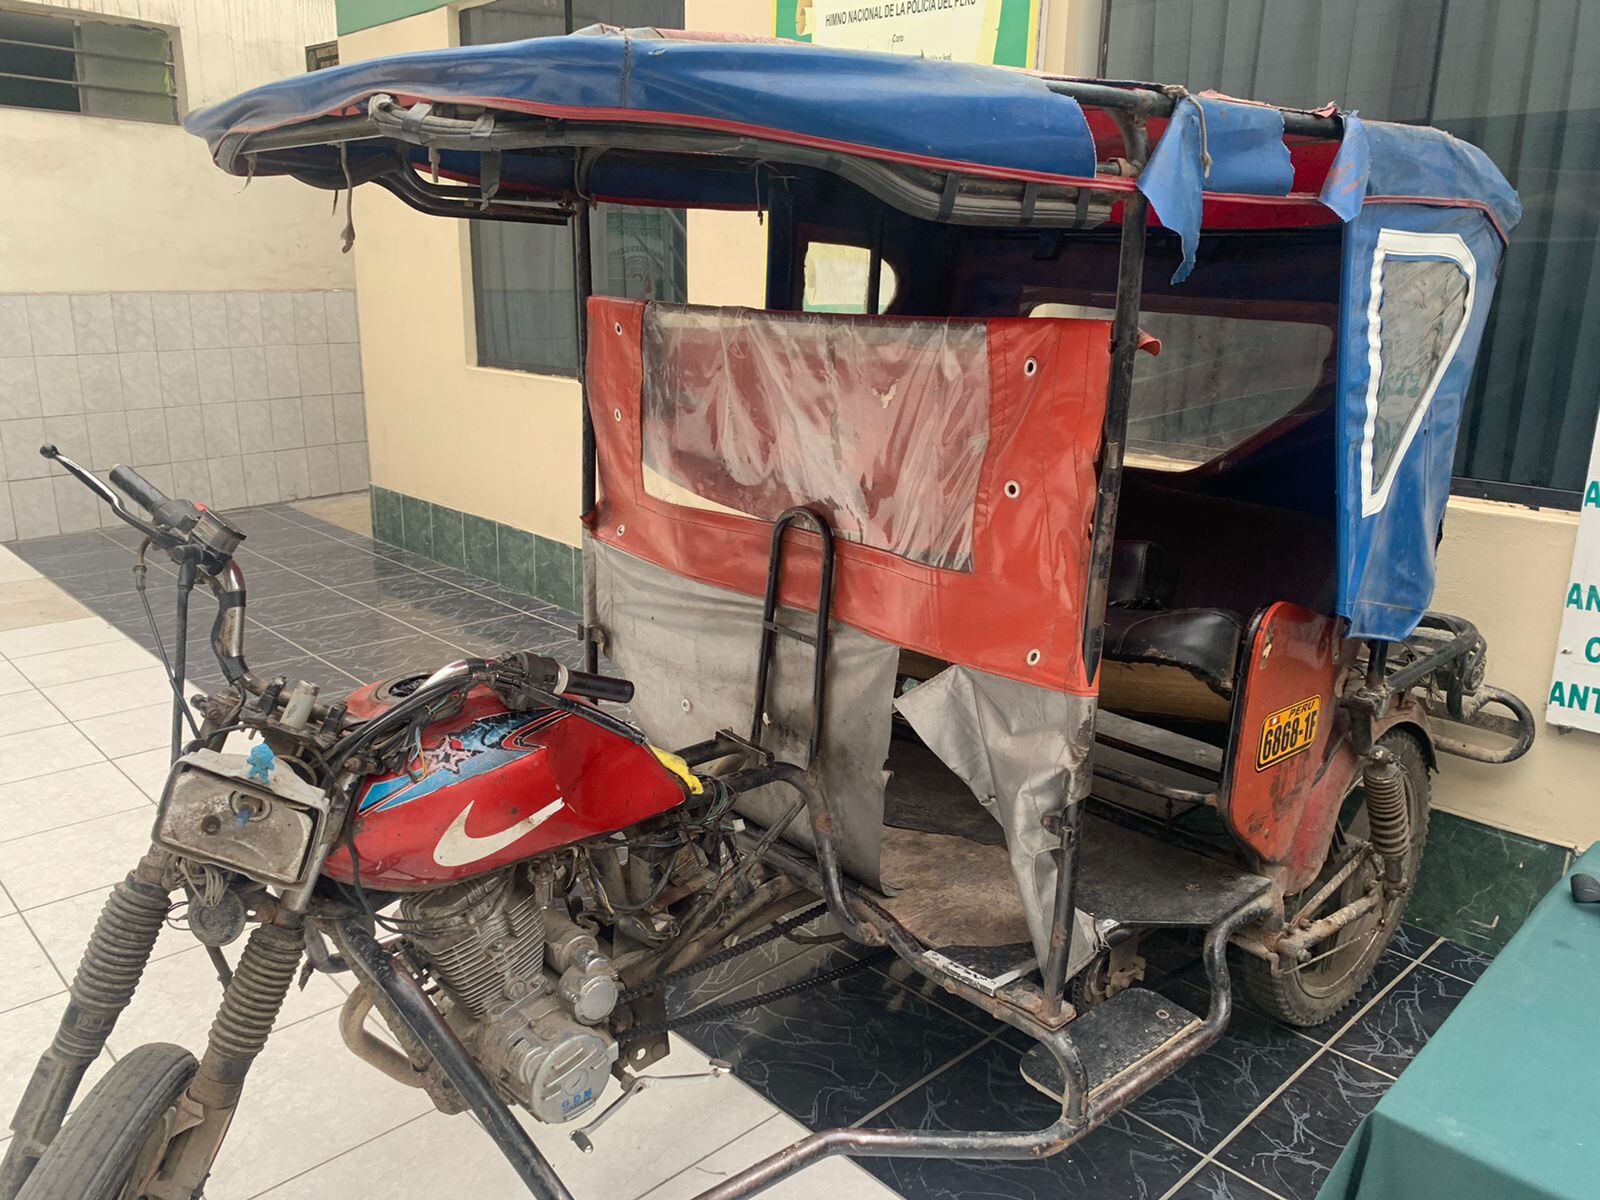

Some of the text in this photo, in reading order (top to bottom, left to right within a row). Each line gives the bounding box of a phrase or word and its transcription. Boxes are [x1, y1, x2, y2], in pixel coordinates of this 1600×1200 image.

[825, 11, 847, 27] HIMNO
[847, 6, 883, 24] NACIONAL
[884, 3, 895, 18] DE
[895, 2, 906, 16] LA
[1288, 700, 1316, 718] PERU
[1263, 710, 1318, 761] 6868-1F
